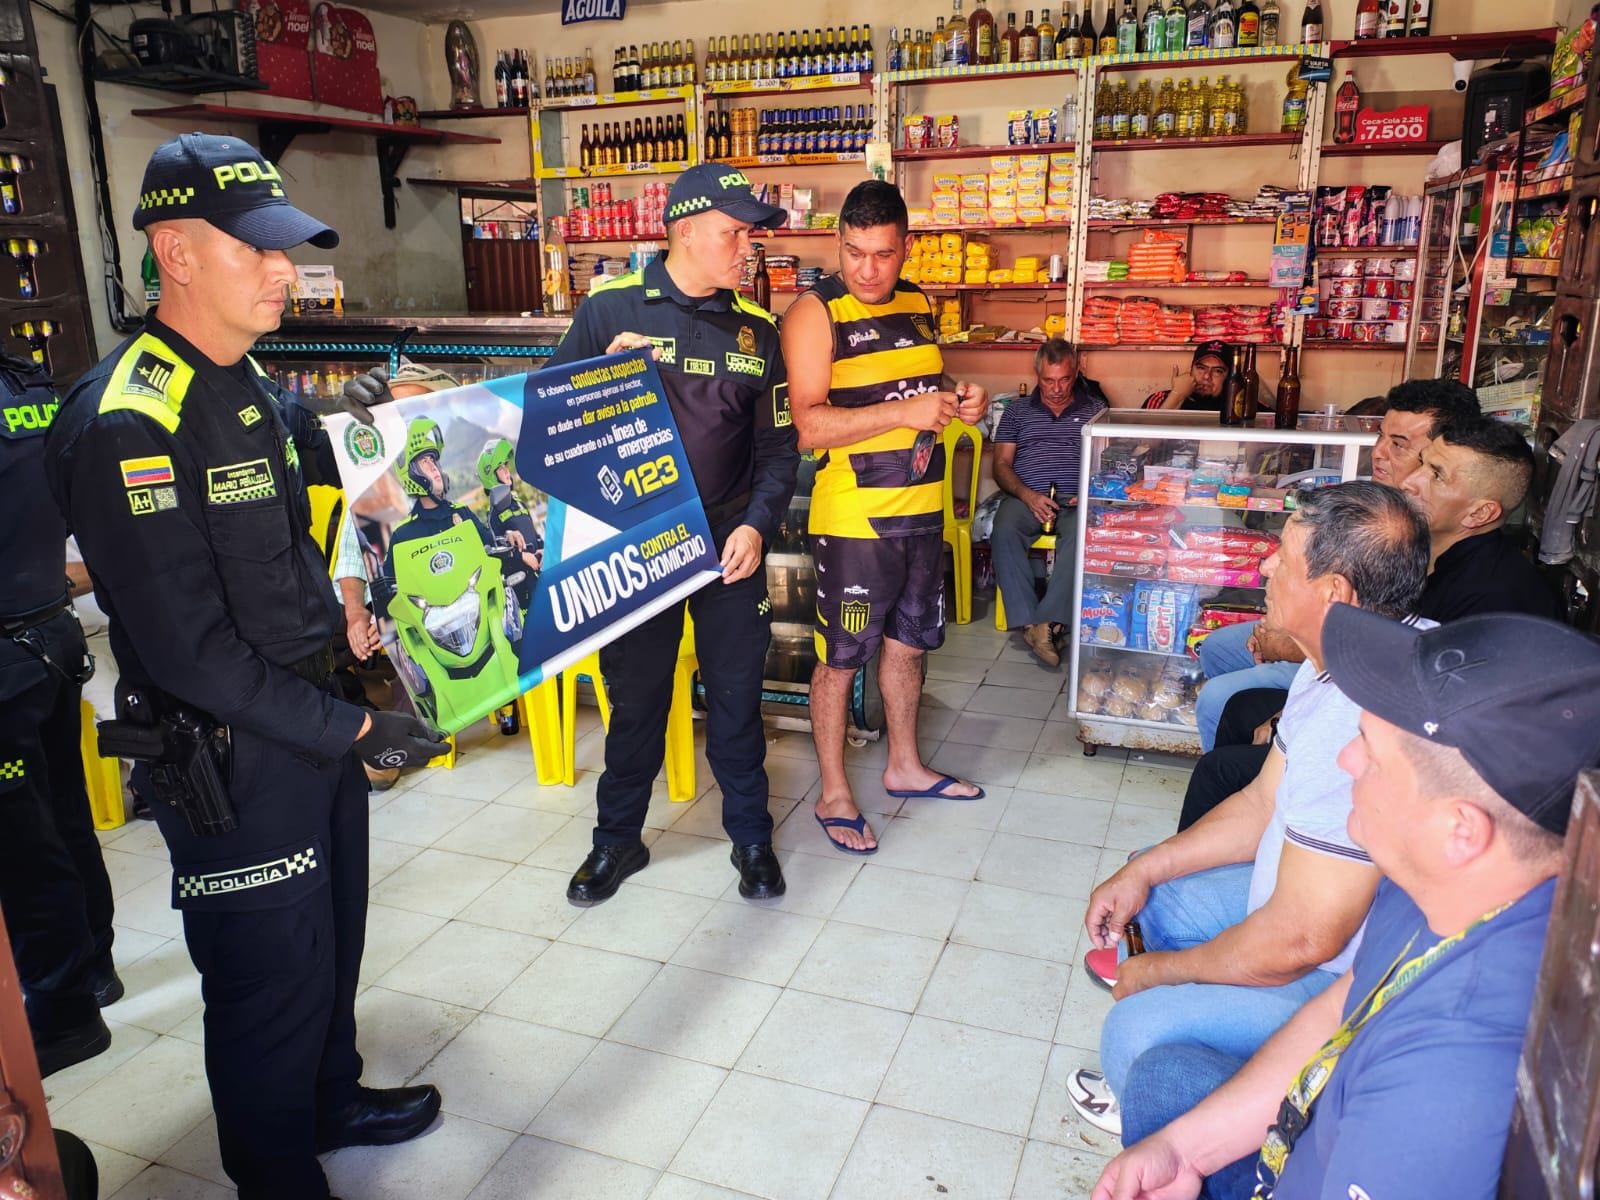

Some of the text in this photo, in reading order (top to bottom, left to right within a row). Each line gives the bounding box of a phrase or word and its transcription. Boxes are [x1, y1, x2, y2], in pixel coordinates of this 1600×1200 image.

[287, 21, 310, 32] noel
[356, 40, 376, 51] noel
[1361, 117, 1401, 126] Coca-Cola
[537, 357, 648, 398] Si observa conductas sospechas
[566, 398, 576, 407] en
[575, 390, 602, 407] personas
[547, 391, 658, 436] no dude en dar aviso a la patrulla
[544, 417, 648, 467] de su cuadrante o a la línea de
[618, 427, 674, 460] emergencias
[213, 480, 238, 492] MARIO
[624, 454, 680, 497] 123
[134, 493, 151, 511] A+
[640, 522, 690, 560] CONTRA EL
[548, 534, 706, 633] UNIDOS HOMICIDIO
[208, 868, 283, 892] POLICÍA
